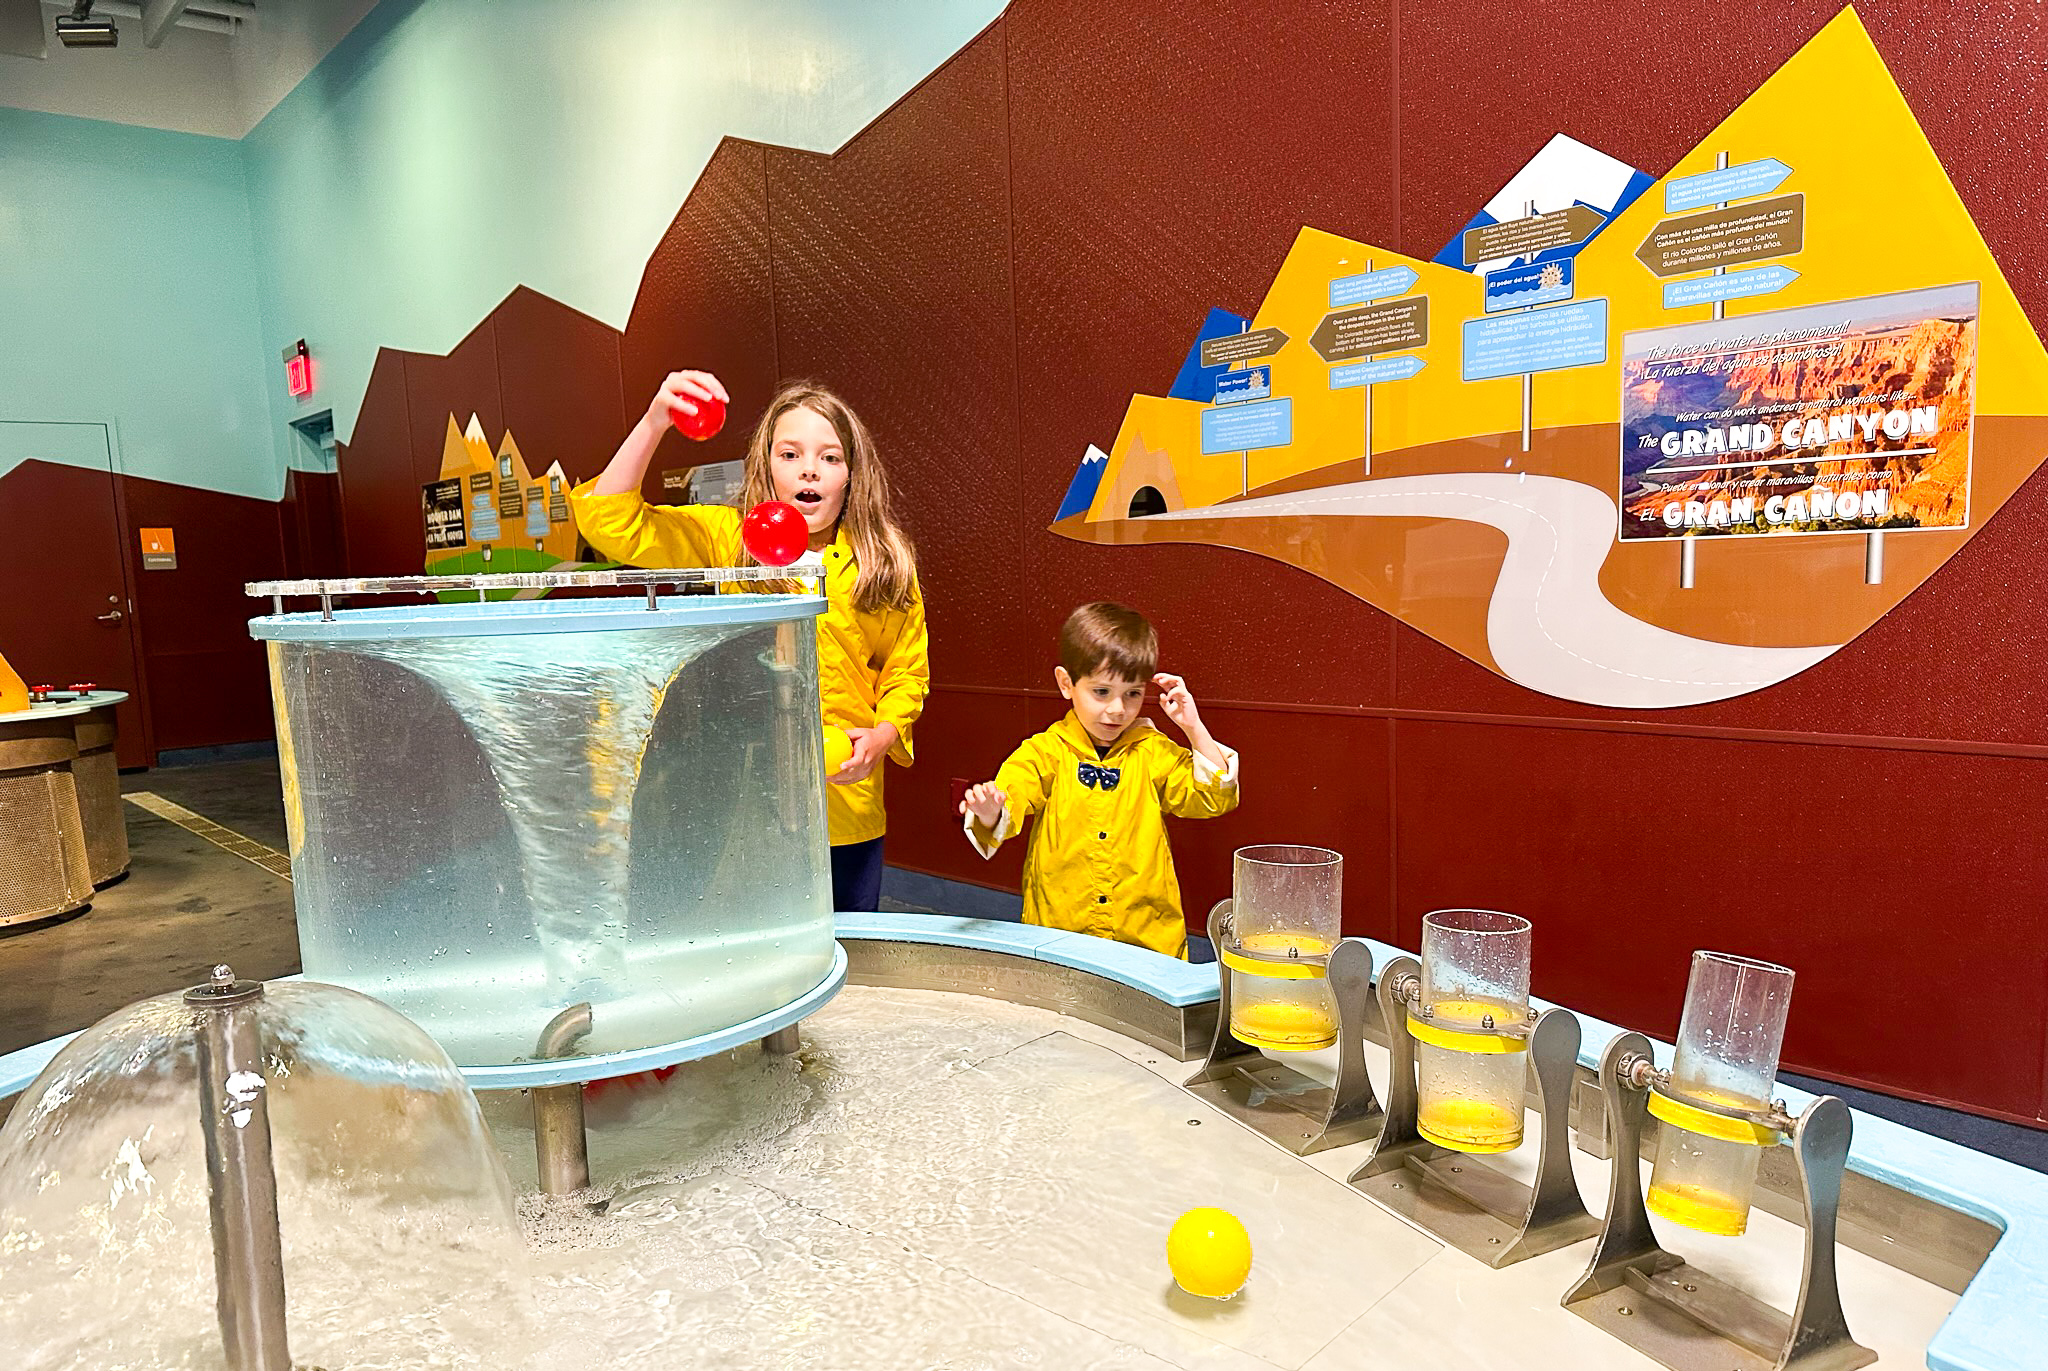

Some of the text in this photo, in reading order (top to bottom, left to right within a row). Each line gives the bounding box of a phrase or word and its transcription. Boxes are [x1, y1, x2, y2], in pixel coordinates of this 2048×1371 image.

[1656, 237, 1675, 248] Cañón
[1685, 235, 1691, 243] el
[1691, 232, 1710, 242] cañón
[1711, 229, 1724, 238] más
[1725, 224, 1753, 236] profundo
[1754, 221, 1764, 229] del
[1765, 217, 1790, 227] mundo!
[1669, 230, 1681, 239] más
[1682, 228, 1690, 236] de
[1691, 226, 1702, 234] una
[1703, 223, 1718, 231] milla
[1719, 221, 1727, 229] de
[1728, 213, 1769, 228] profundidad,
[1769, 211, 1776, 219] el
[1777, 209, 1793, 218] Gran
[1662, 251, 1669, 259] El
[1680, 245, 1711, 256] Colorado
[1728, 240, 1734, 248] el
[1735, 236, 1753, 246] Gran
[1754, 232, 1778, 243] Cañón
[1662, 239, 1782, 268] durante millones y millones de años.
[1674, 291, 1711, 303] maravillas
[1712, 289, 1725, 297] del
[1726, 283, 1752, 295] mundo
[1683, 283, 1702, 293] Gran
[1703, 279, 1728, 290] Cañón
[1739, 275, 1755, 283] una
[1756, 273, 1767, 281] de
[1768, 271, 1780, 279] las
[1647, 319, 1852, 360] The force of water is phenomenal!
[1640, 342, 1846, 381] ¡La fuerza del agua es asombrosa!
[1676, 410, 1703, 423] Water
[1703, 411, 1719, 420] can
[1721, 406, 1732, 418] do
[1733, 404, 1757, 416] work
[1806, 396, 1843, 409] natural
[1844, 391, 1889, 406] wonders
[1638, 405, 1938, 458] The GRAND CANYON
[1660, 480, 1688, 493] Puede
[1731, 481, 1739, 490] y
[1739, 478, 1766, 488] crear
[1766, 474, 1815, 487] maravillas
[1816, 471, 1864, 484] naturales
[1866, 469, 1894, 481] como
[1639, 485, 1889, 529] EL GRAN CAÑON
